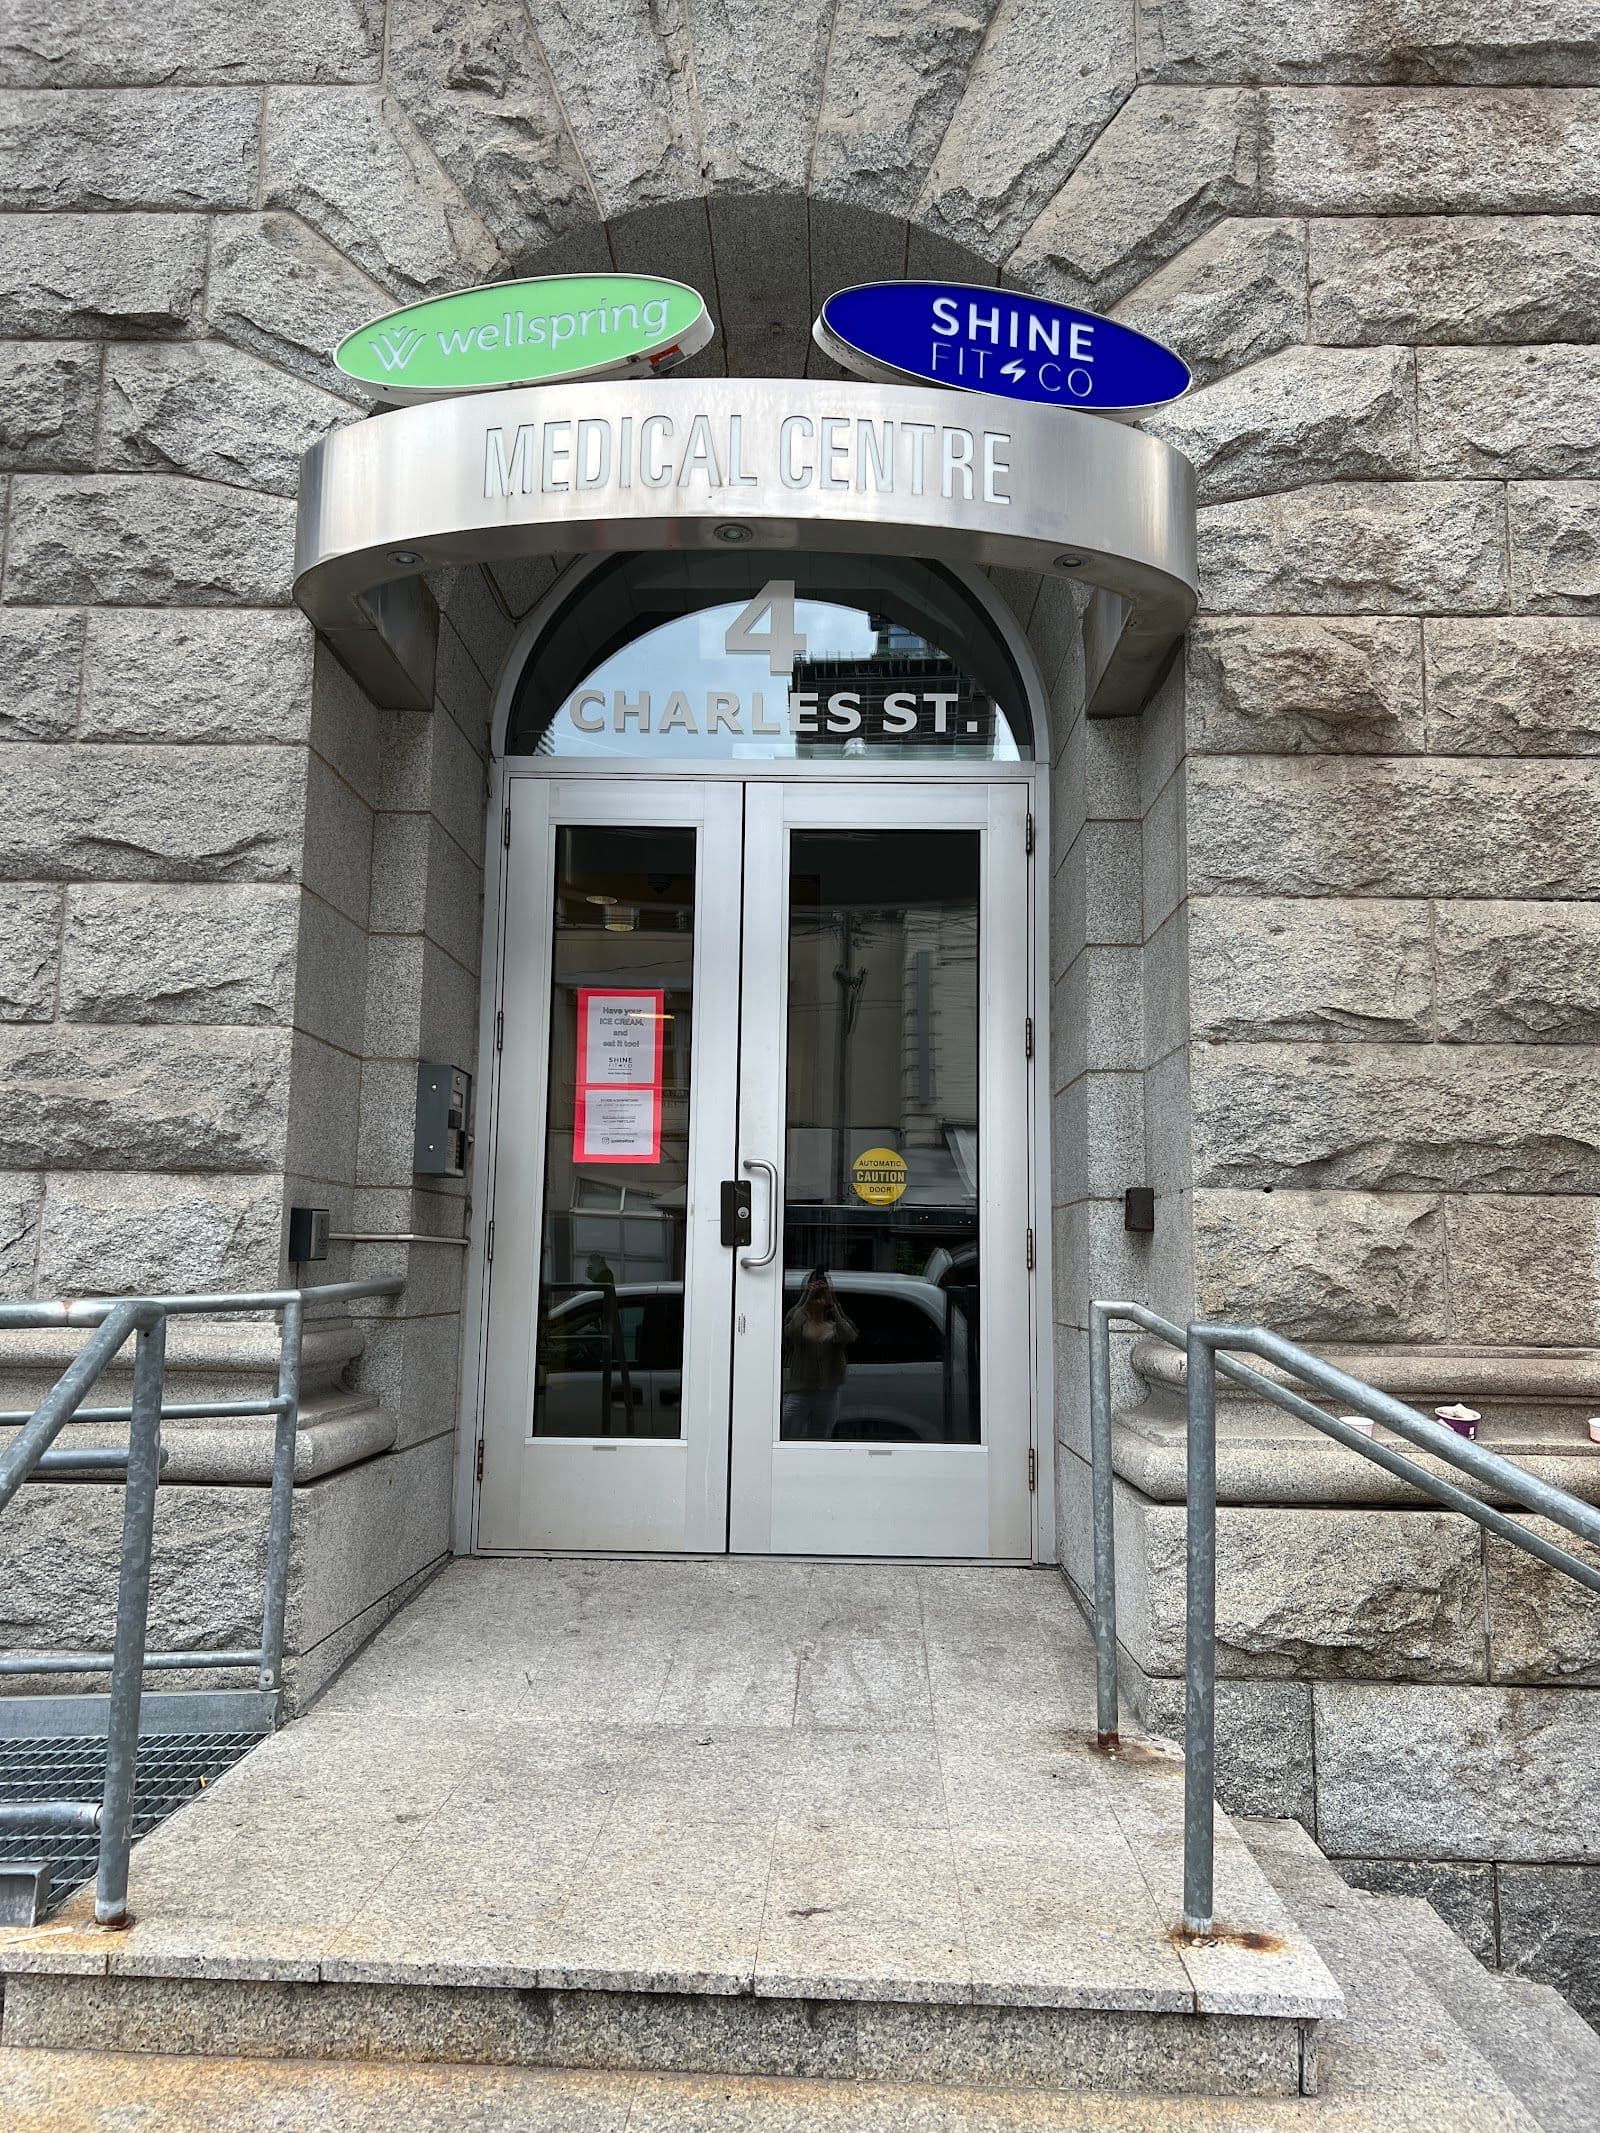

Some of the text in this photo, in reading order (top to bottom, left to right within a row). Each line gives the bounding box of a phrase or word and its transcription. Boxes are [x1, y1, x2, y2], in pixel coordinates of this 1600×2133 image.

[436, 297, 671, 357] wellspring
[931, 297, 1095, 363] SHINE
[931, 342, 1094, 399] FIT CO
[484, 414, 1012, 506] MEDICAL CENTRE
[725, 579, 807, 676] 4
[569, 689, 979, 734] CHARLES ST.
[599, 1017, 613, 1025] ICE
[602, 1006, 623, 1015] Have
[613, 1029, 628, 1037] and
[856, 1170, 905, 1183] CAUTION
